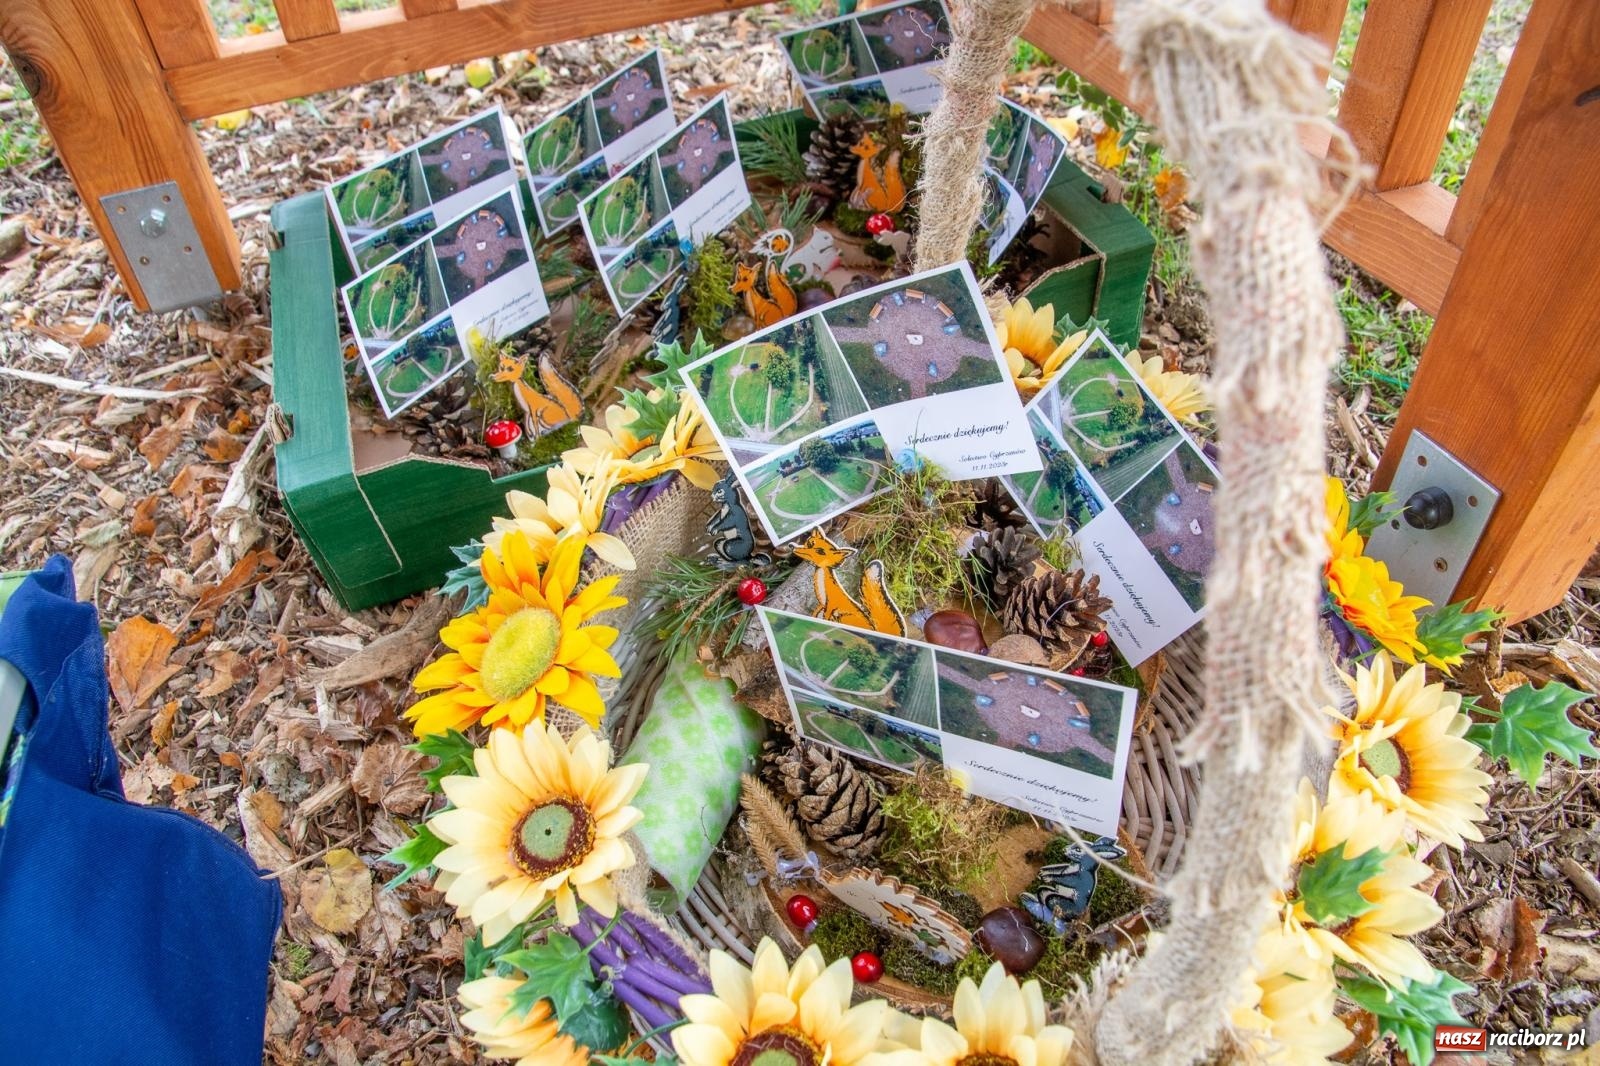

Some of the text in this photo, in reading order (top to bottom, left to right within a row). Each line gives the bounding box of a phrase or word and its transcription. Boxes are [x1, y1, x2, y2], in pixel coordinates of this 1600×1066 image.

[904, 421, 1009, 446] Serdecznie dziękujemy!
[1092, 540, 1124, 582] Serdecznie
